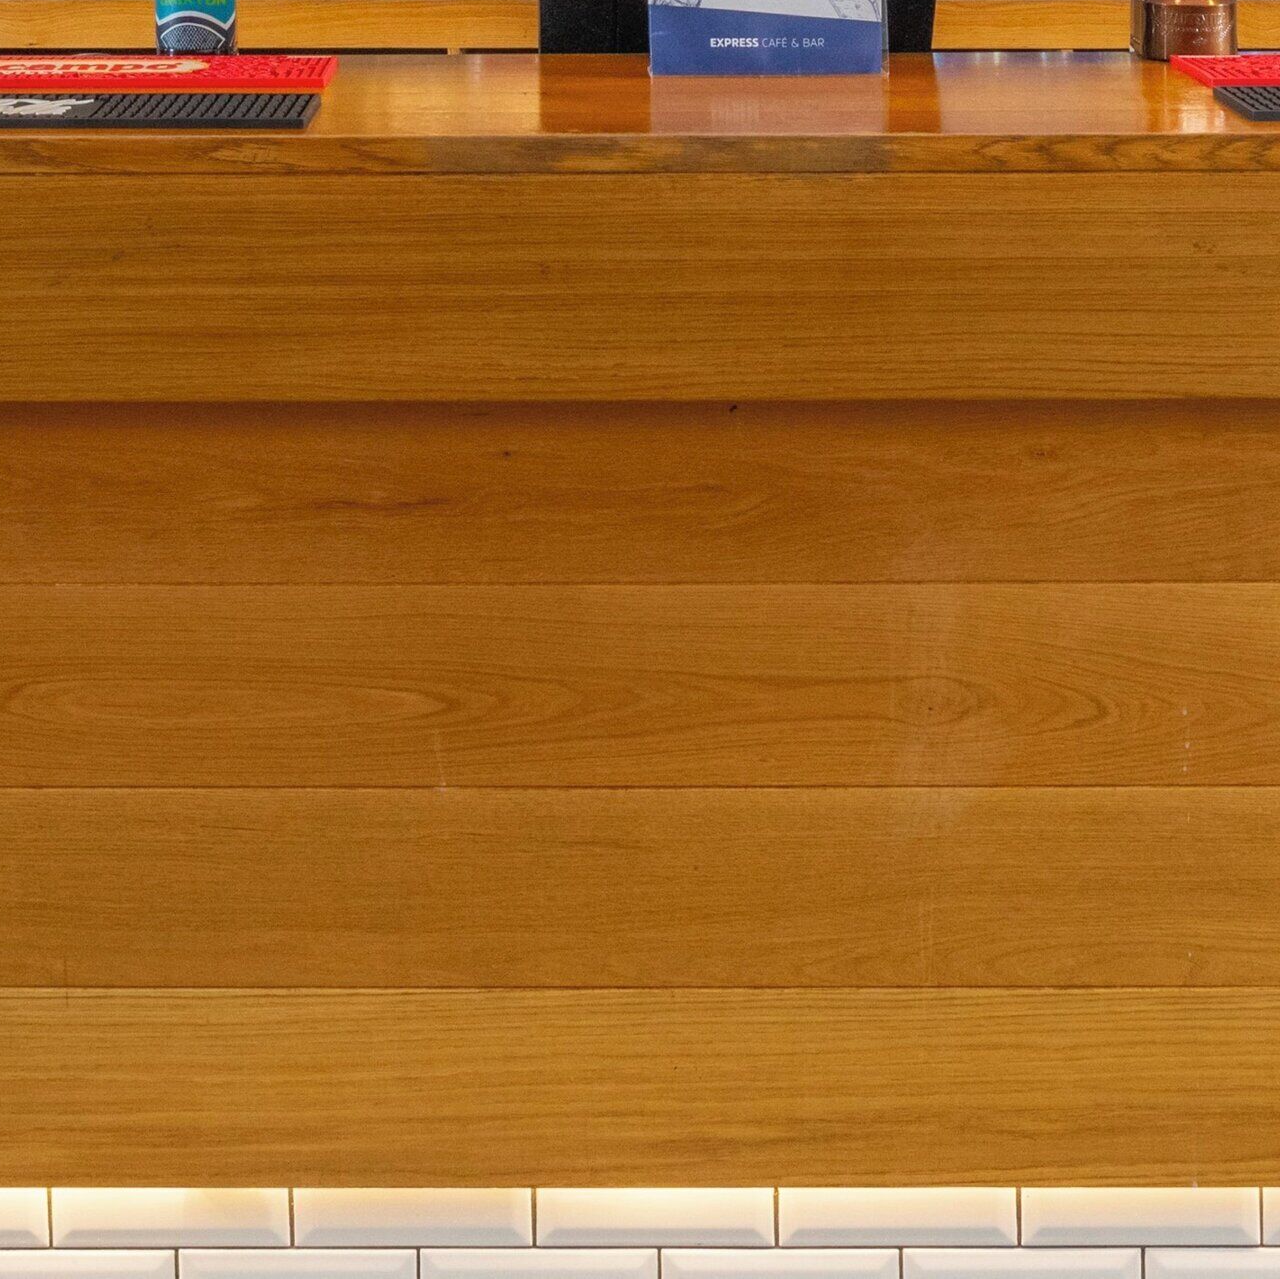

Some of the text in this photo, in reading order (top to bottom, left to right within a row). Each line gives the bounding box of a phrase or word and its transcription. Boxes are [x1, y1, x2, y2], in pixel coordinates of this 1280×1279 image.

[710, 36, 825, 48] EXPRESS CAFÉ & BAR
